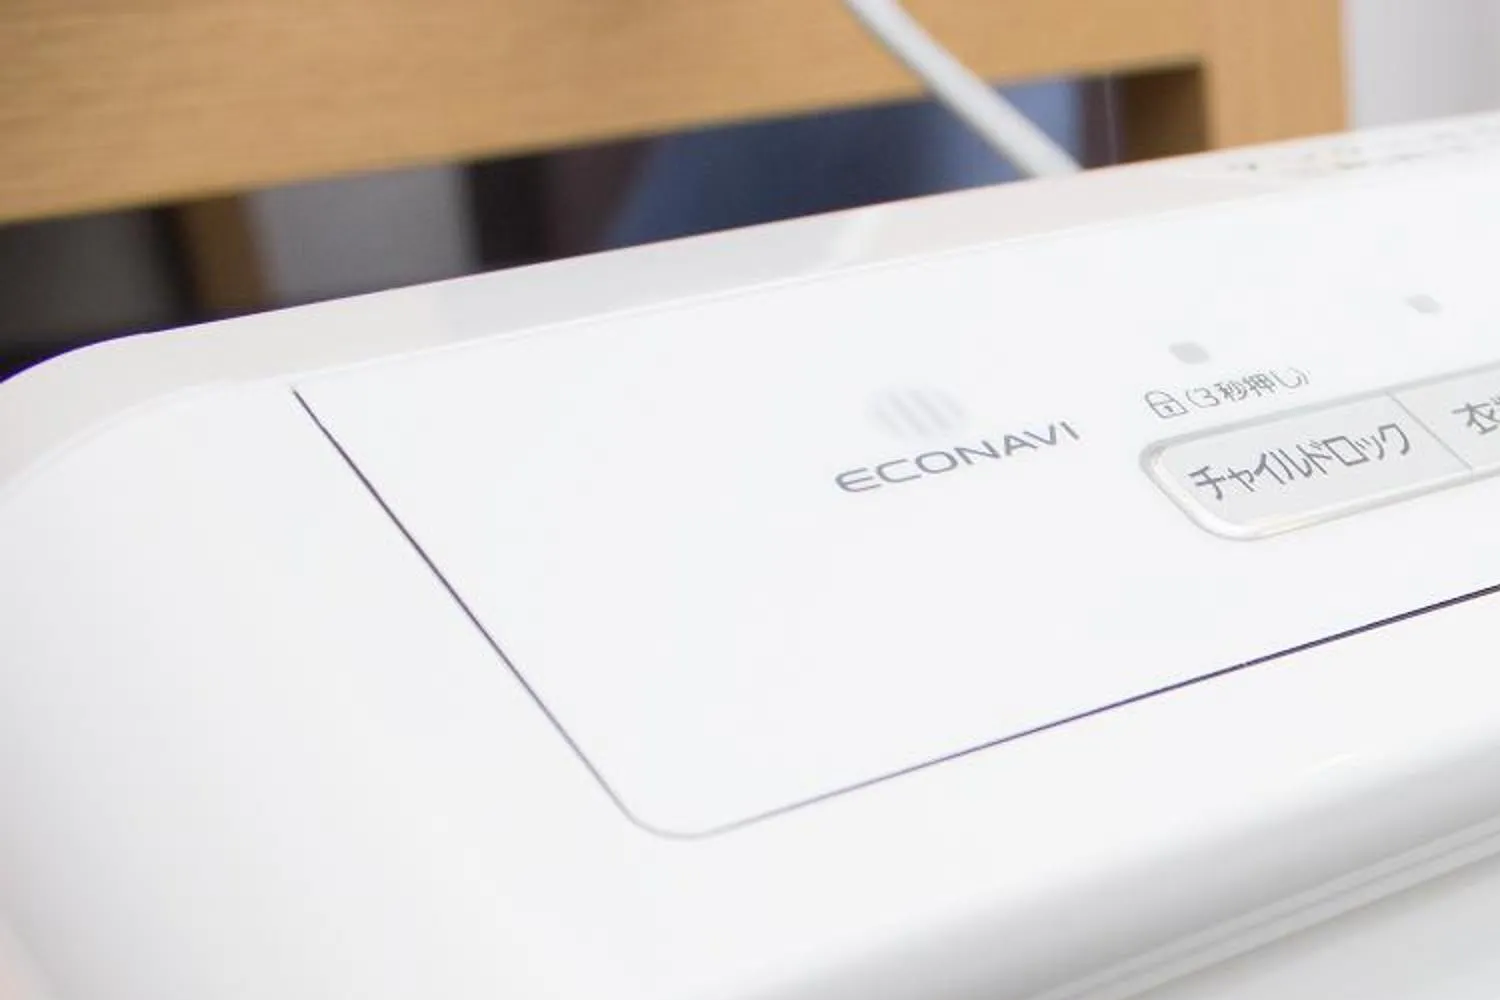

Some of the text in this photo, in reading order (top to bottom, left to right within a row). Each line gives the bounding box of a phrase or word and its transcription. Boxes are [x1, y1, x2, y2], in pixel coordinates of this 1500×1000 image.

[834, 420, 1081, 493] ECONAVI
[1188, 423, 1411, 501] チャイルドロック
